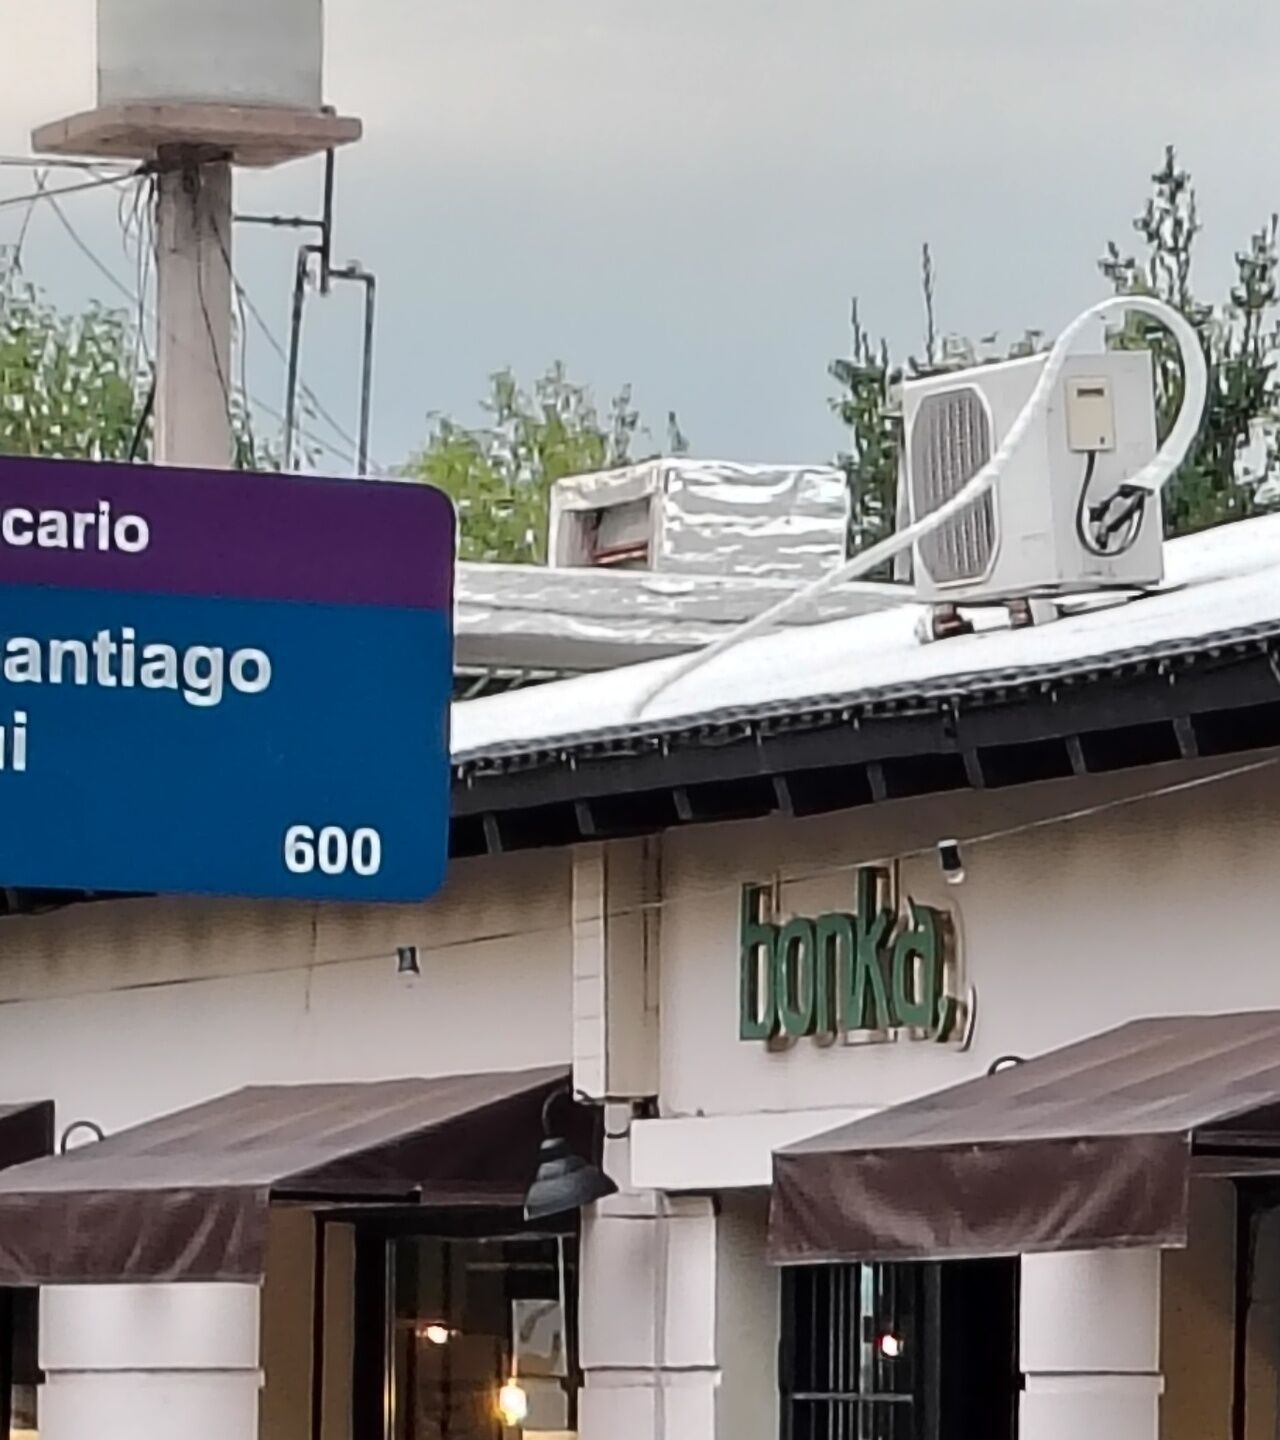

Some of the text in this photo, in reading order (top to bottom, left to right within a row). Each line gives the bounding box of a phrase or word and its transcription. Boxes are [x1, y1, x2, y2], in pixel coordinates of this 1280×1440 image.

[2, 502, 149, 552] cario
[4, 627, 271, 706] antiago
[284, 825, 381, 875] 600
